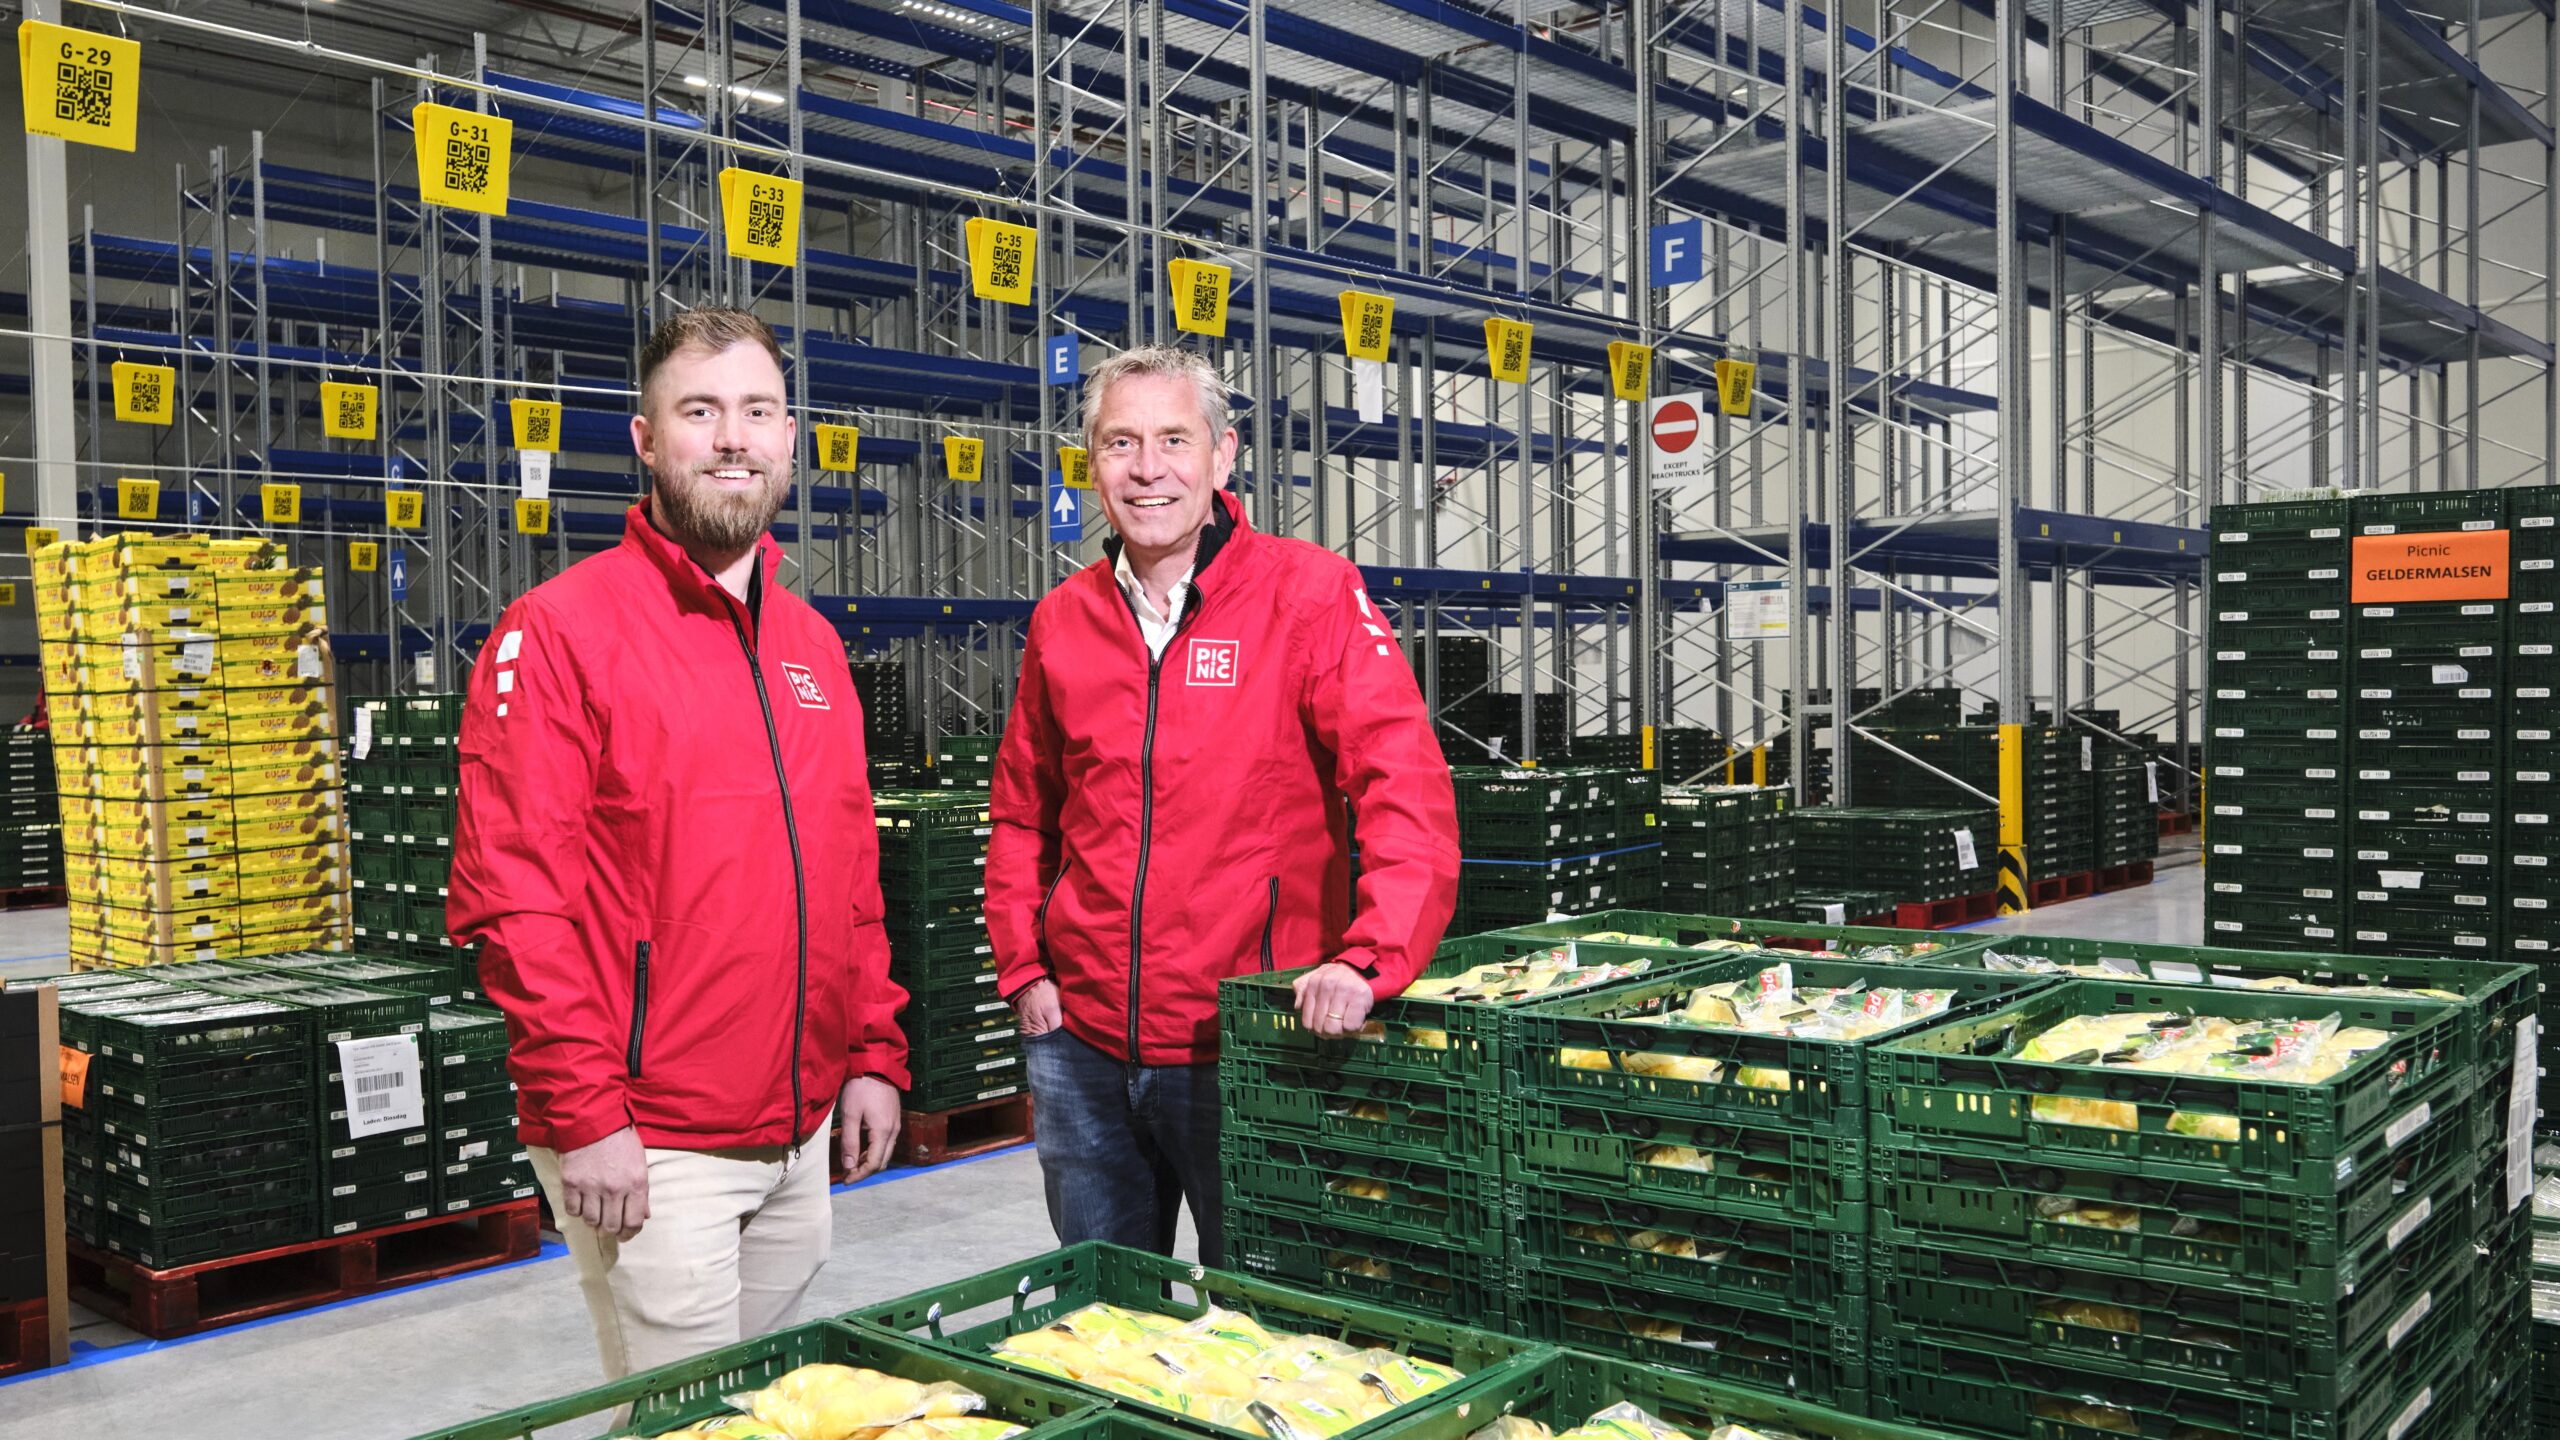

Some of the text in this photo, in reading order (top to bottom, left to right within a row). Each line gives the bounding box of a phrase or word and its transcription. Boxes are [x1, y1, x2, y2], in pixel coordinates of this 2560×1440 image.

[60, 42, 111, 66] G-29
[450, 121, 489, 143] G-31
[752, 184, 784, 202] G-33
[995, 231, 1022, 248] G-35
[1664, 237, 1685, 272] F
[1196, 271, 1218, 283] G-37
[1364, 302, 1383, 314] G-39
[1507, 328, 1523, 340] G-41
[1055, 346, 1069, 374] E
[1629, 350, 1644, 362] G-43
[133, 371, 160, 383] F-33
[341, 391, 365, 401] F-35
[529, 407, 550, 416] F-37
[832, 431, 849, 440] F-41
[959, 443, 976, 451] F-43
[391, 464, 400, 479] C
[1663, 461, 1688, 470] EXCEPT
[1675, 469, 1700, 478] TRUCKS
[192, 500, 199, 516] B
[2407, 544, 2451, 557] Picnic
[2366, 565, 2492, 581] GELDERMALSEN
[1196, 647, 1231, 664] PIC
[788, 671, 815, 689] PIC
